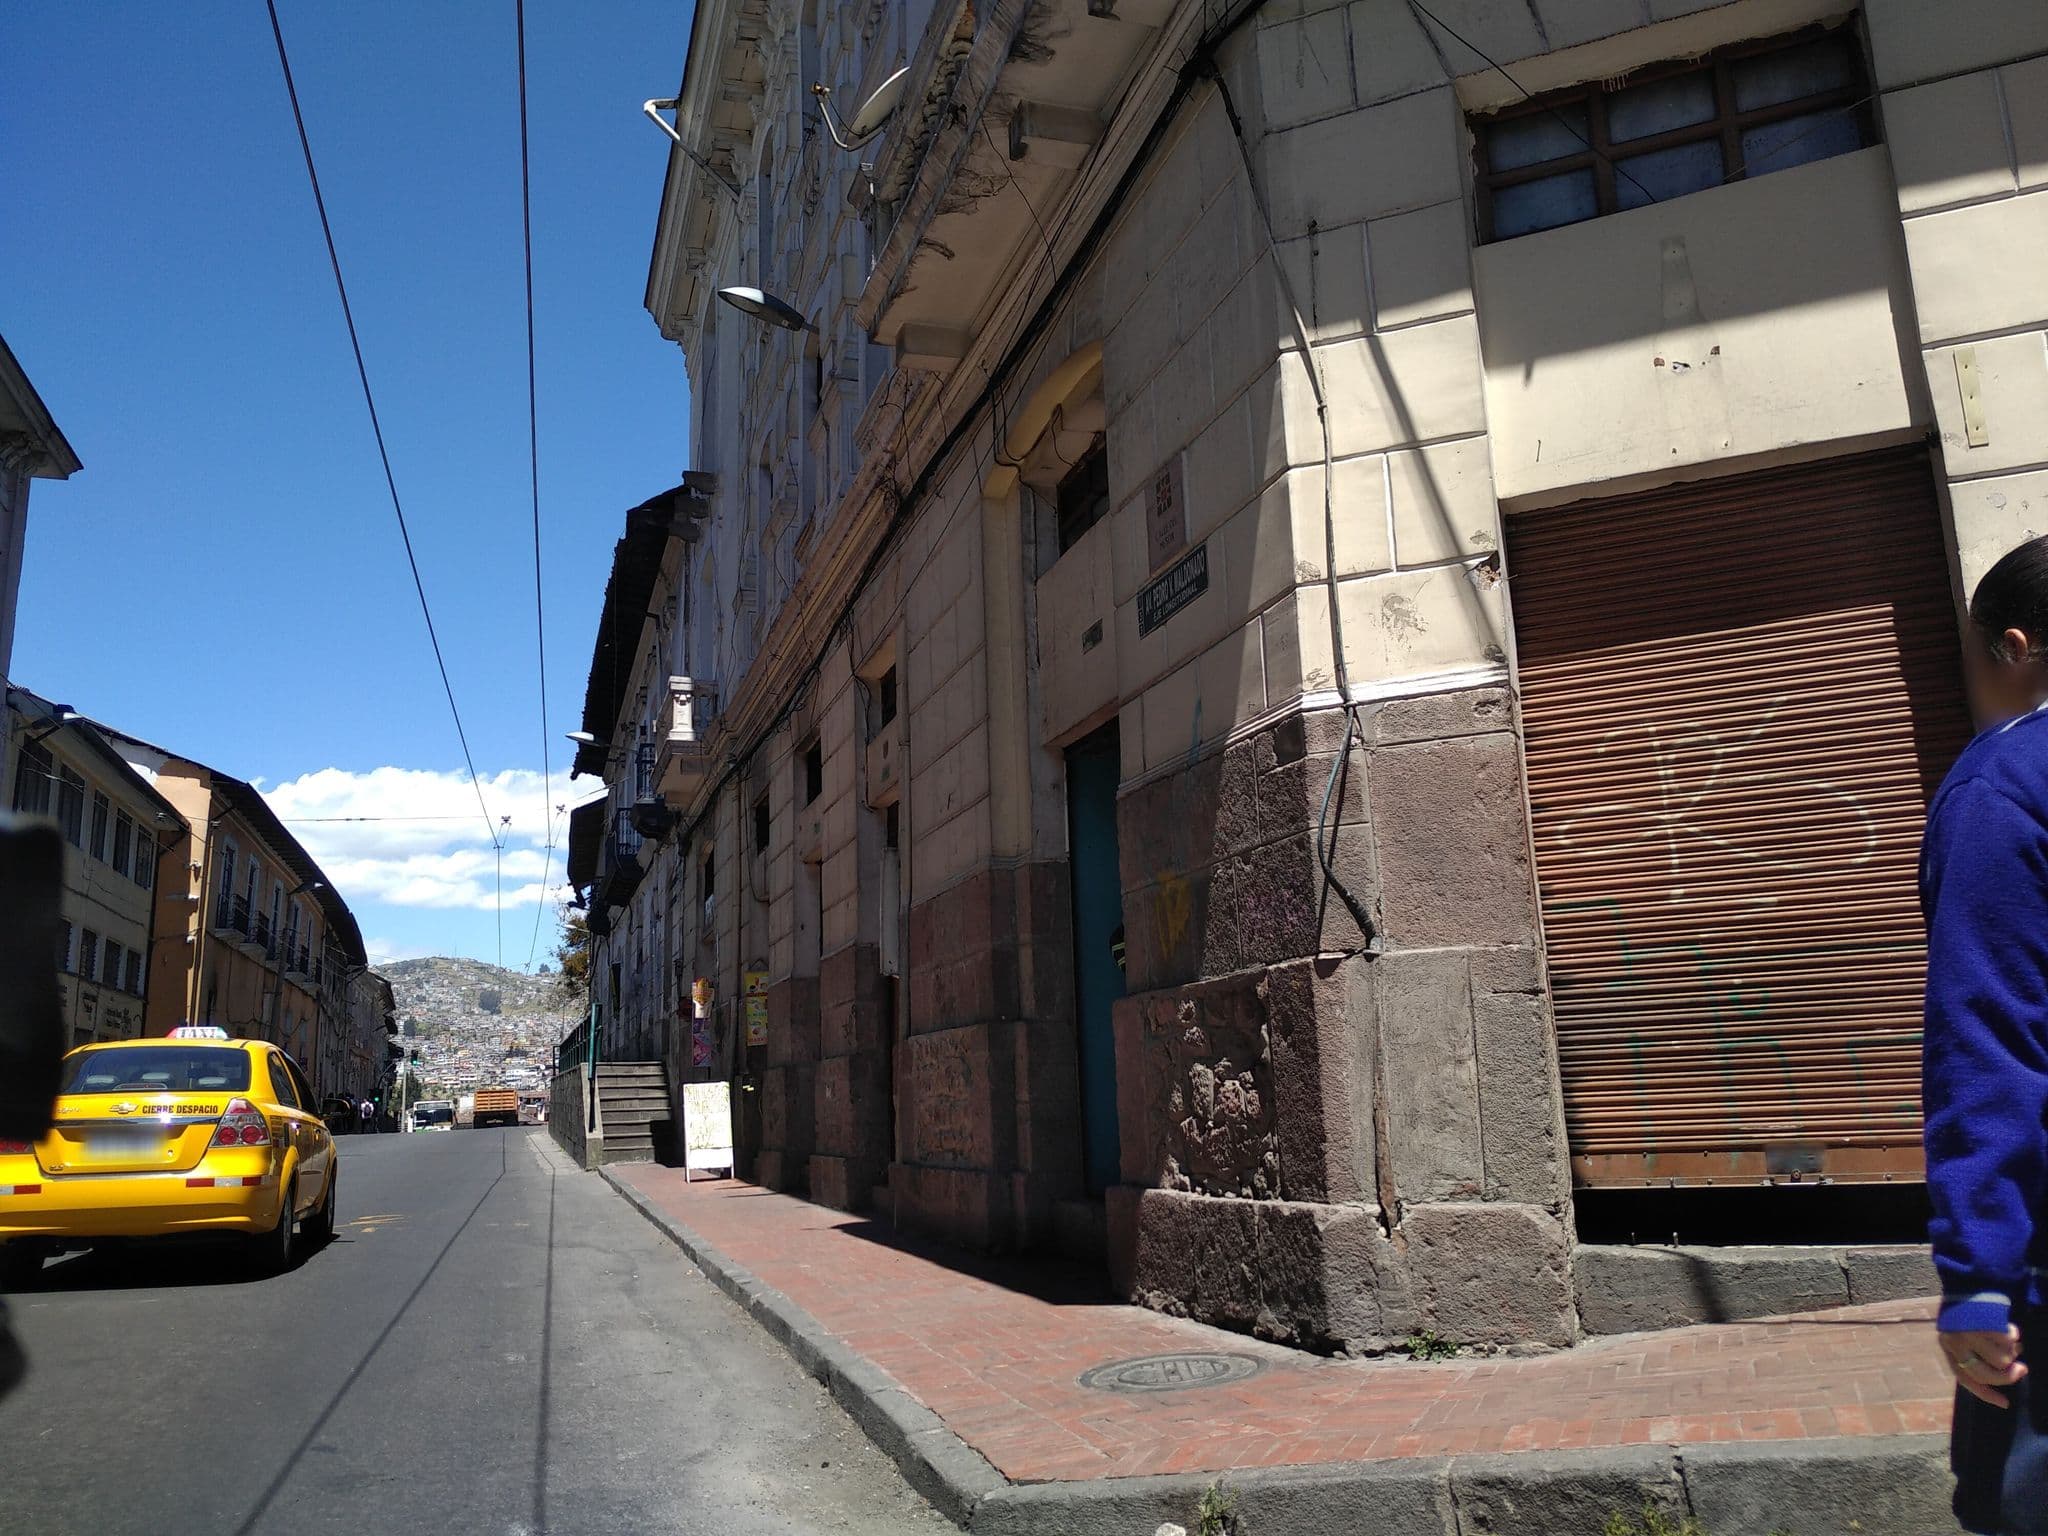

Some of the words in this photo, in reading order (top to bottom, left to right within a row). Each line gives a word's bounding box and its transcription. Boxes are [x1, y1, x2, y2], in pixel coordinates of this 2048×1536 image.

[1153, 579, 1168, 610] PEDRO
[1174, 550, 1205, 595] MALDONADO
[179, 1028, 216, 1038] TAXI
[142, 1105, 174, 1114] CIERRE
[176, 1105, 218, 1114] DESPACIO
